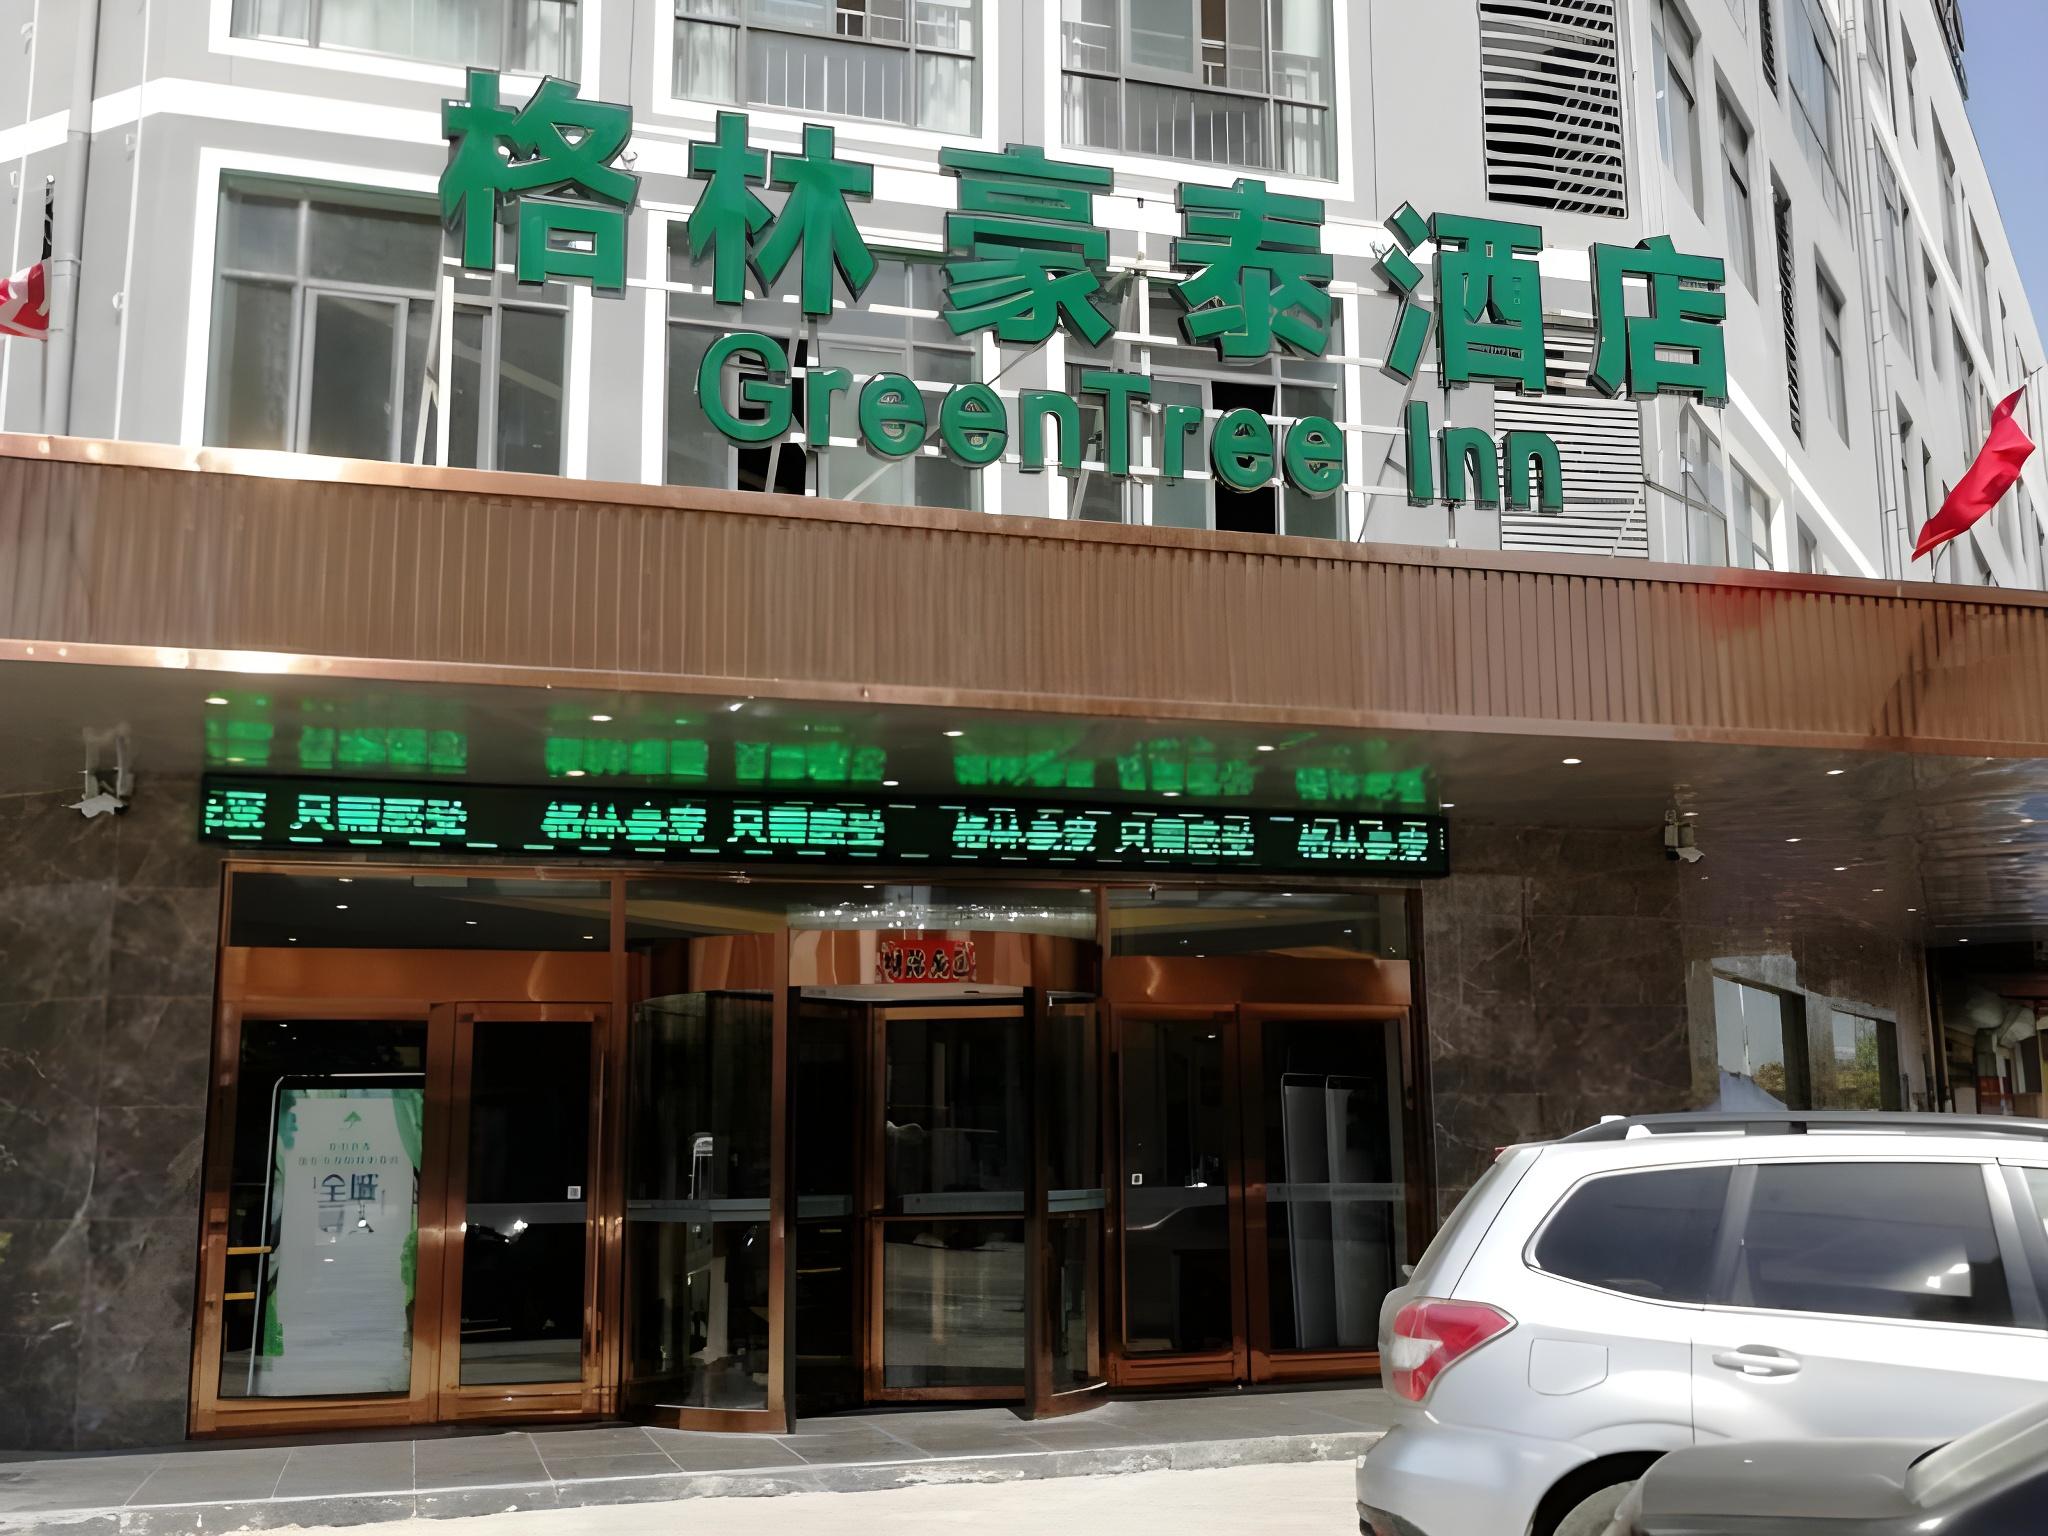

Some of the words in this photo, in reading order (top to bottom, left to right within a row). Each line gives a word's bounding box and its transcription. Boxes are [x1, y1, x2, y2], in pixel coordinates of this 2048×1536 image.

[439, 66, 1728, 408] 格林豪泰酒店
[696, 331, 1346, 499] GreenTree
[1404, 399, 1564, 513] Inn
